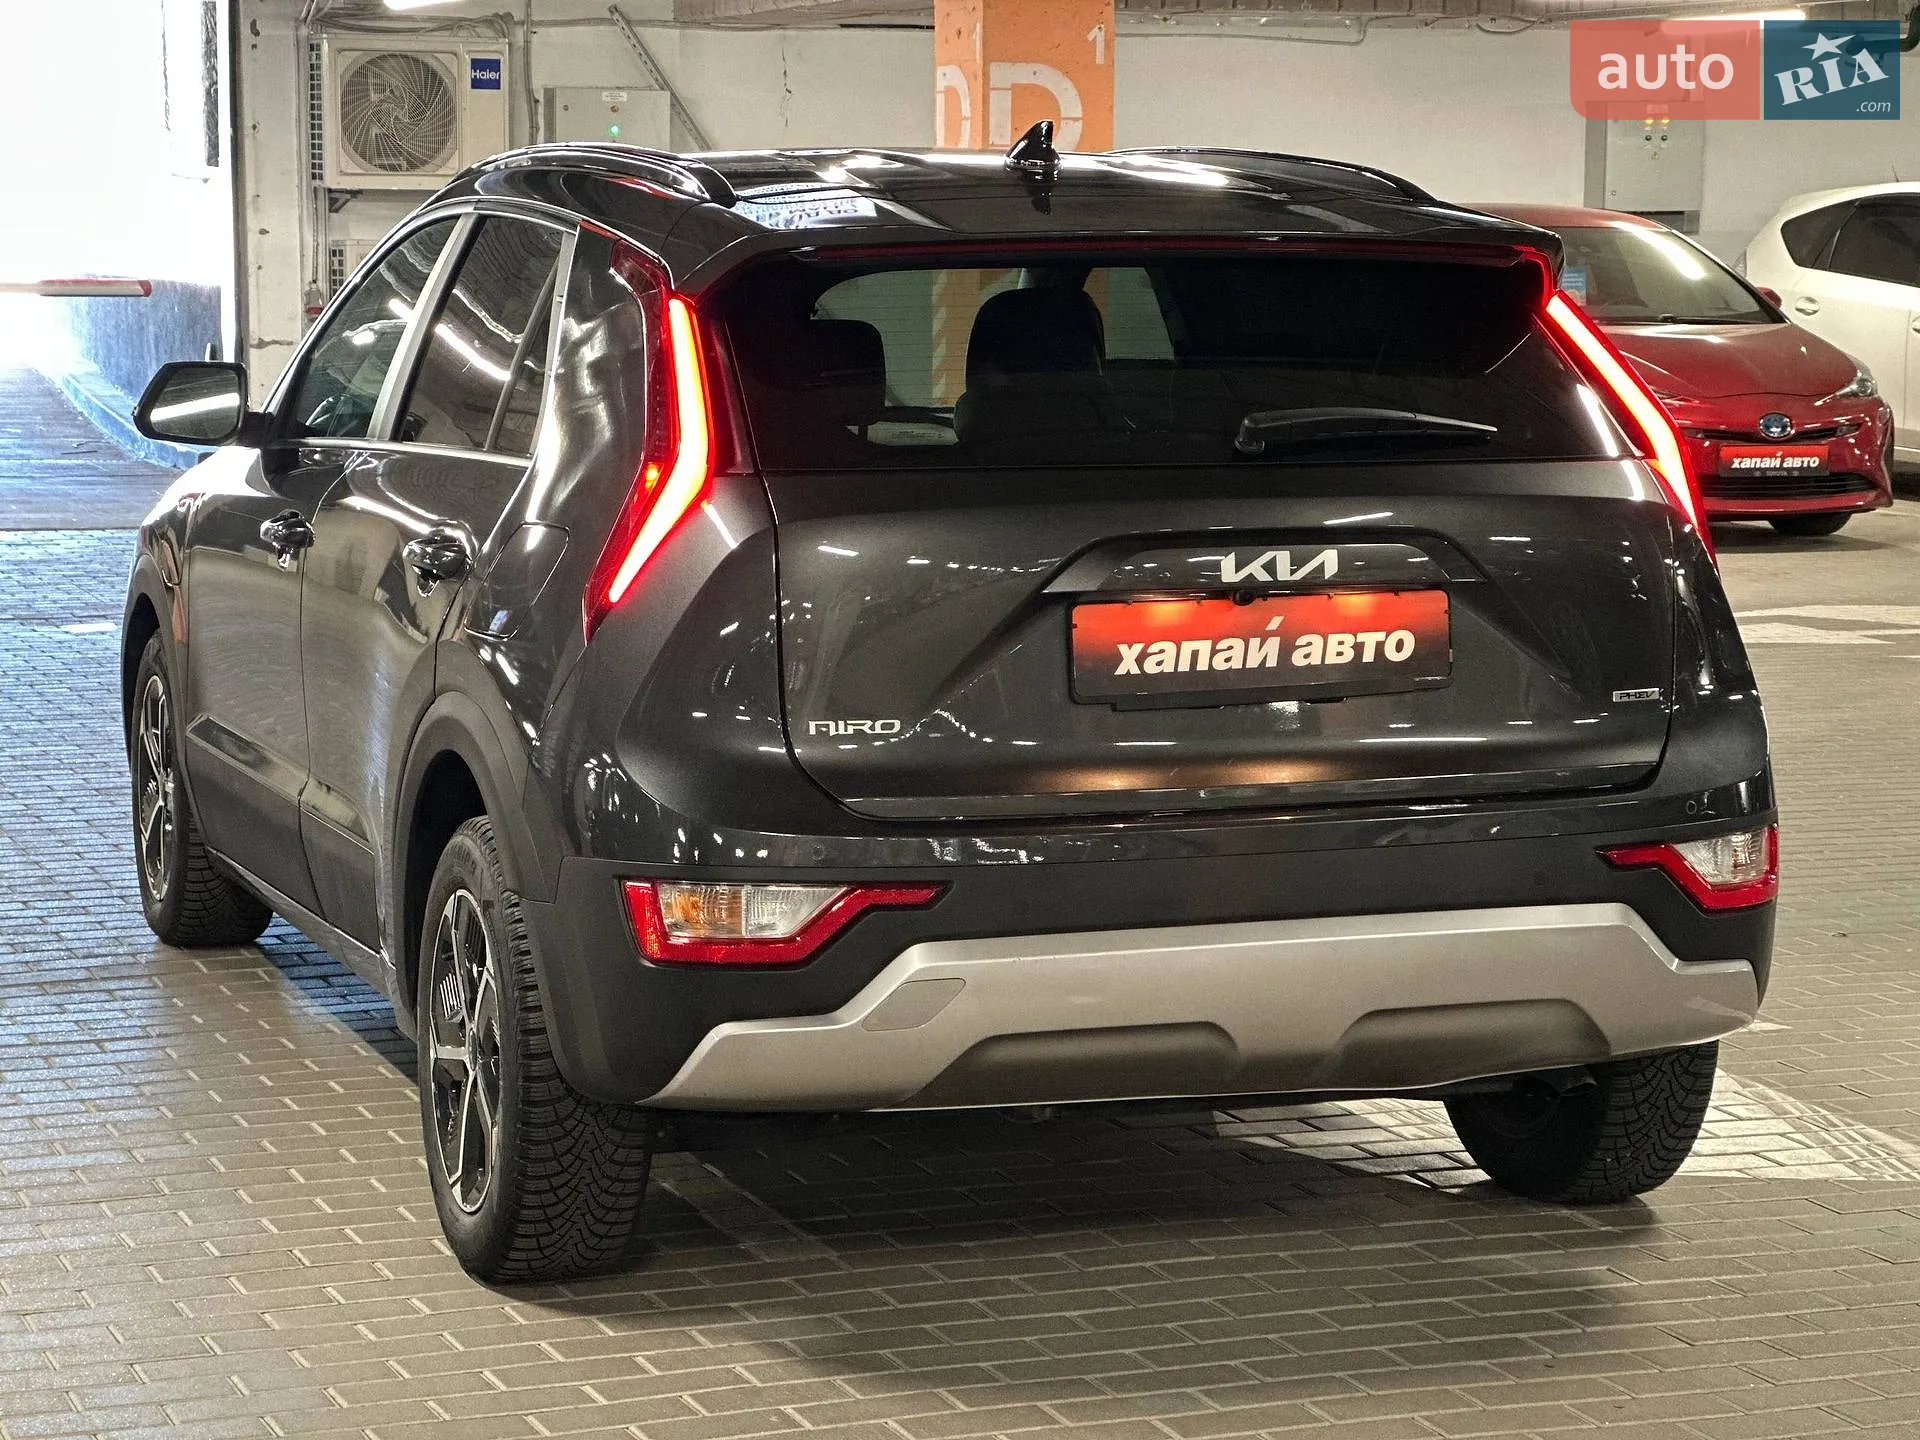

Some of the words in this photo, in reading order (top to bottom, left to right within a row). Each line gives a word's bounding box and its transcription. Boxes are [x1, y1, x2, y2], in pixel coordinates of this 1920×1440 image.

[1086, 24, 1105, 64] 1
[471, 68, 500, 79] Haier
[1783, 456, 1819, 467] авто
[1291, 629, 1416, 666] авто
[1619, 690, 1656, 699] PHEV
